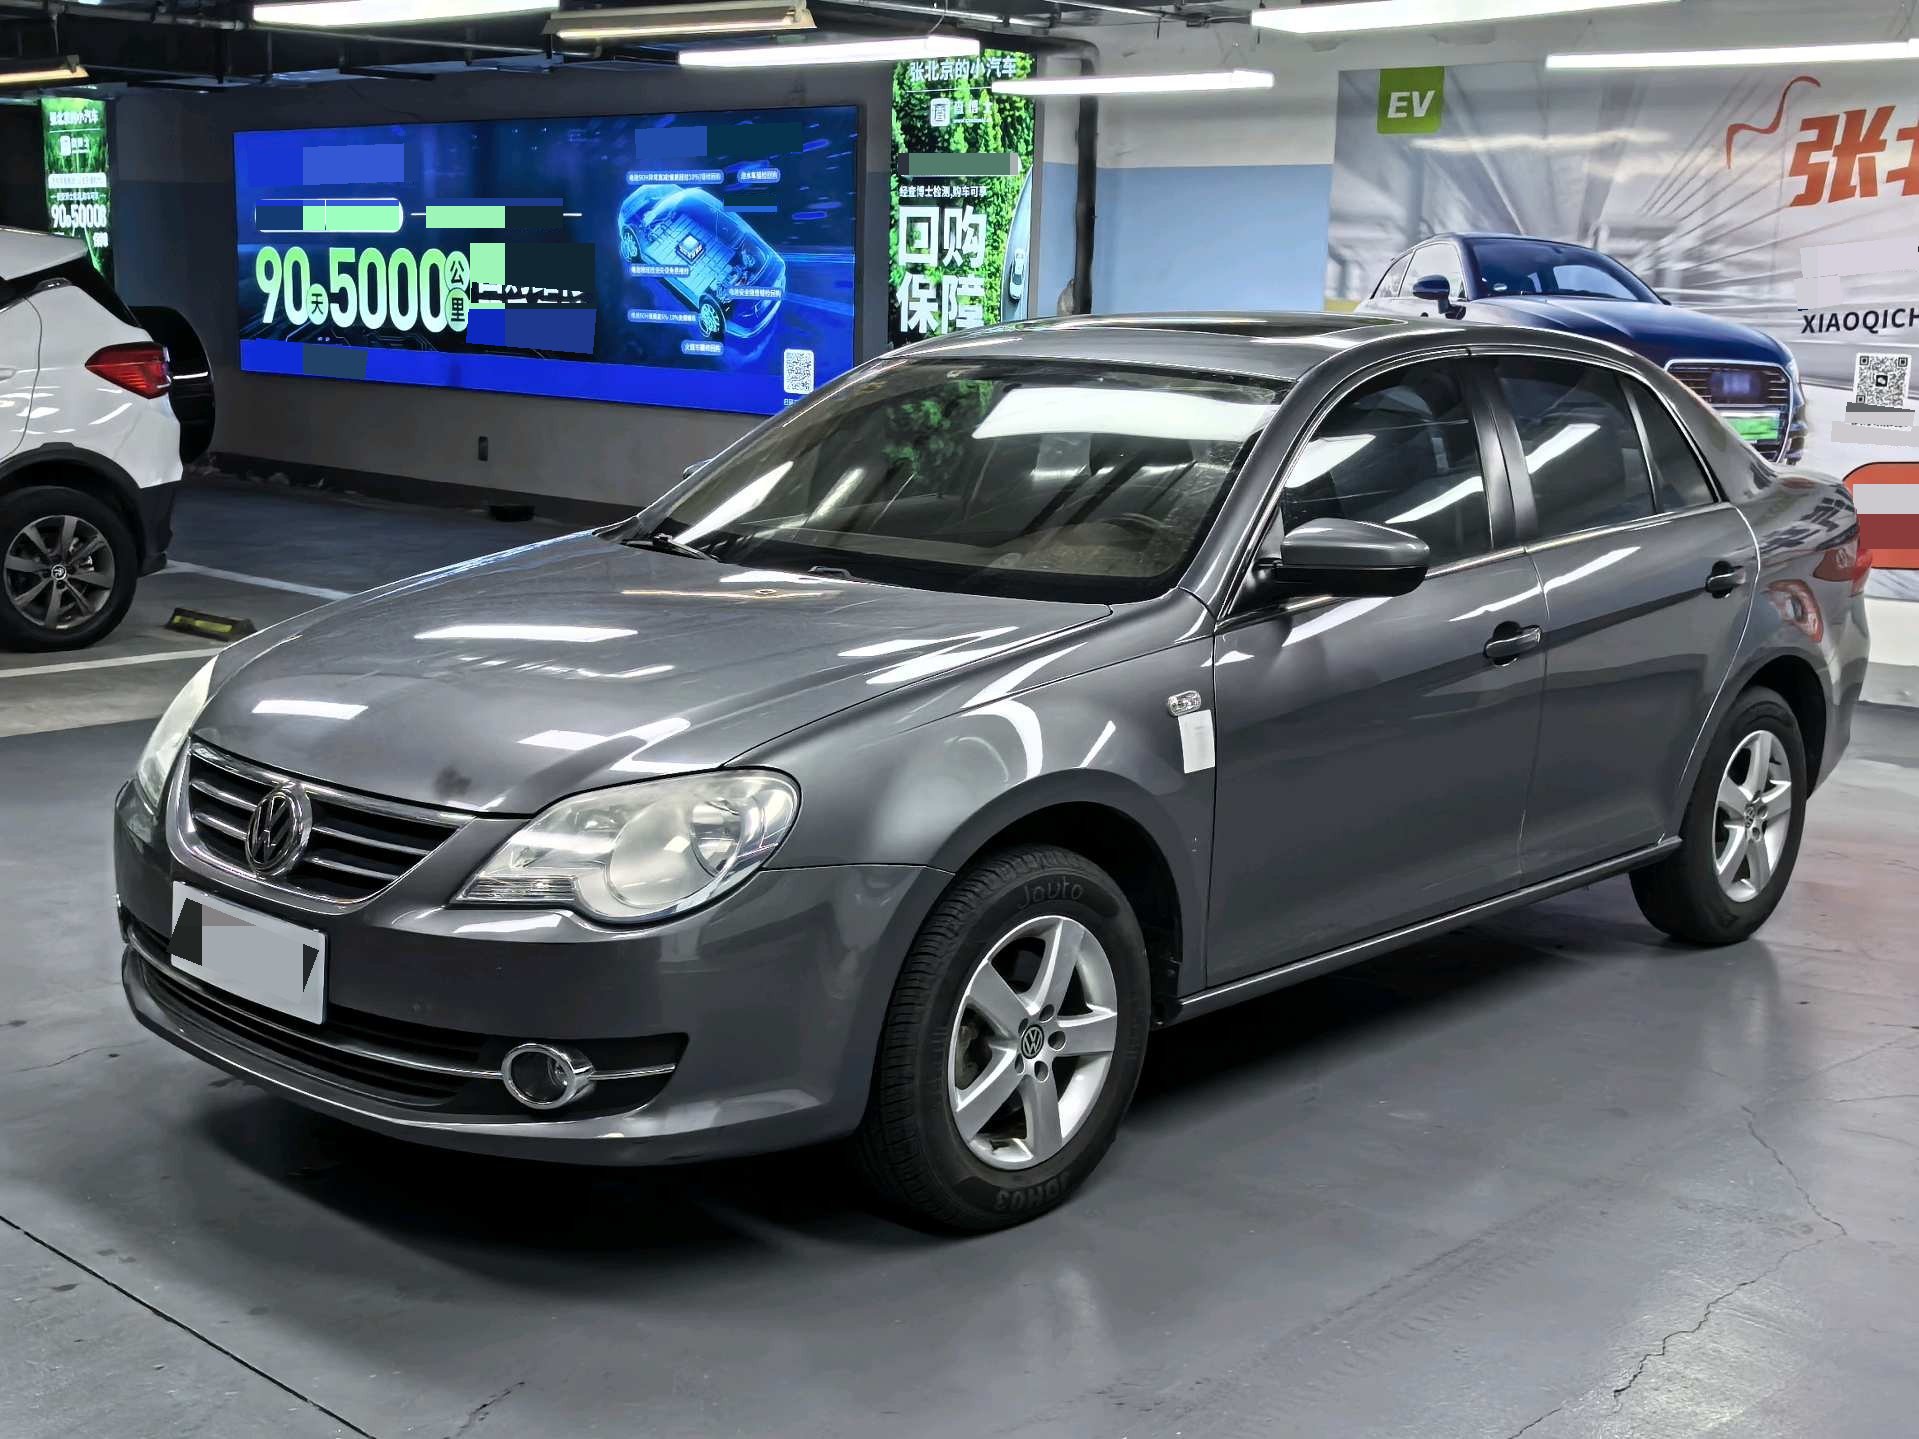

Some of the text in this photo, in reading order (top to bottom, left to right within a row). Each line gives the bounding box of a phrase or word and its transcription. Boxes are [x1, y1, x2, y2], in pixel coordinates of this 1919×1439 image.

[910, 57, 1017, 82] 张北京的小汽车
[1387, 90, 1435, 119] EV
[898, 204, 988, 269] 回购
[896, 271, 986, 335] 保障
